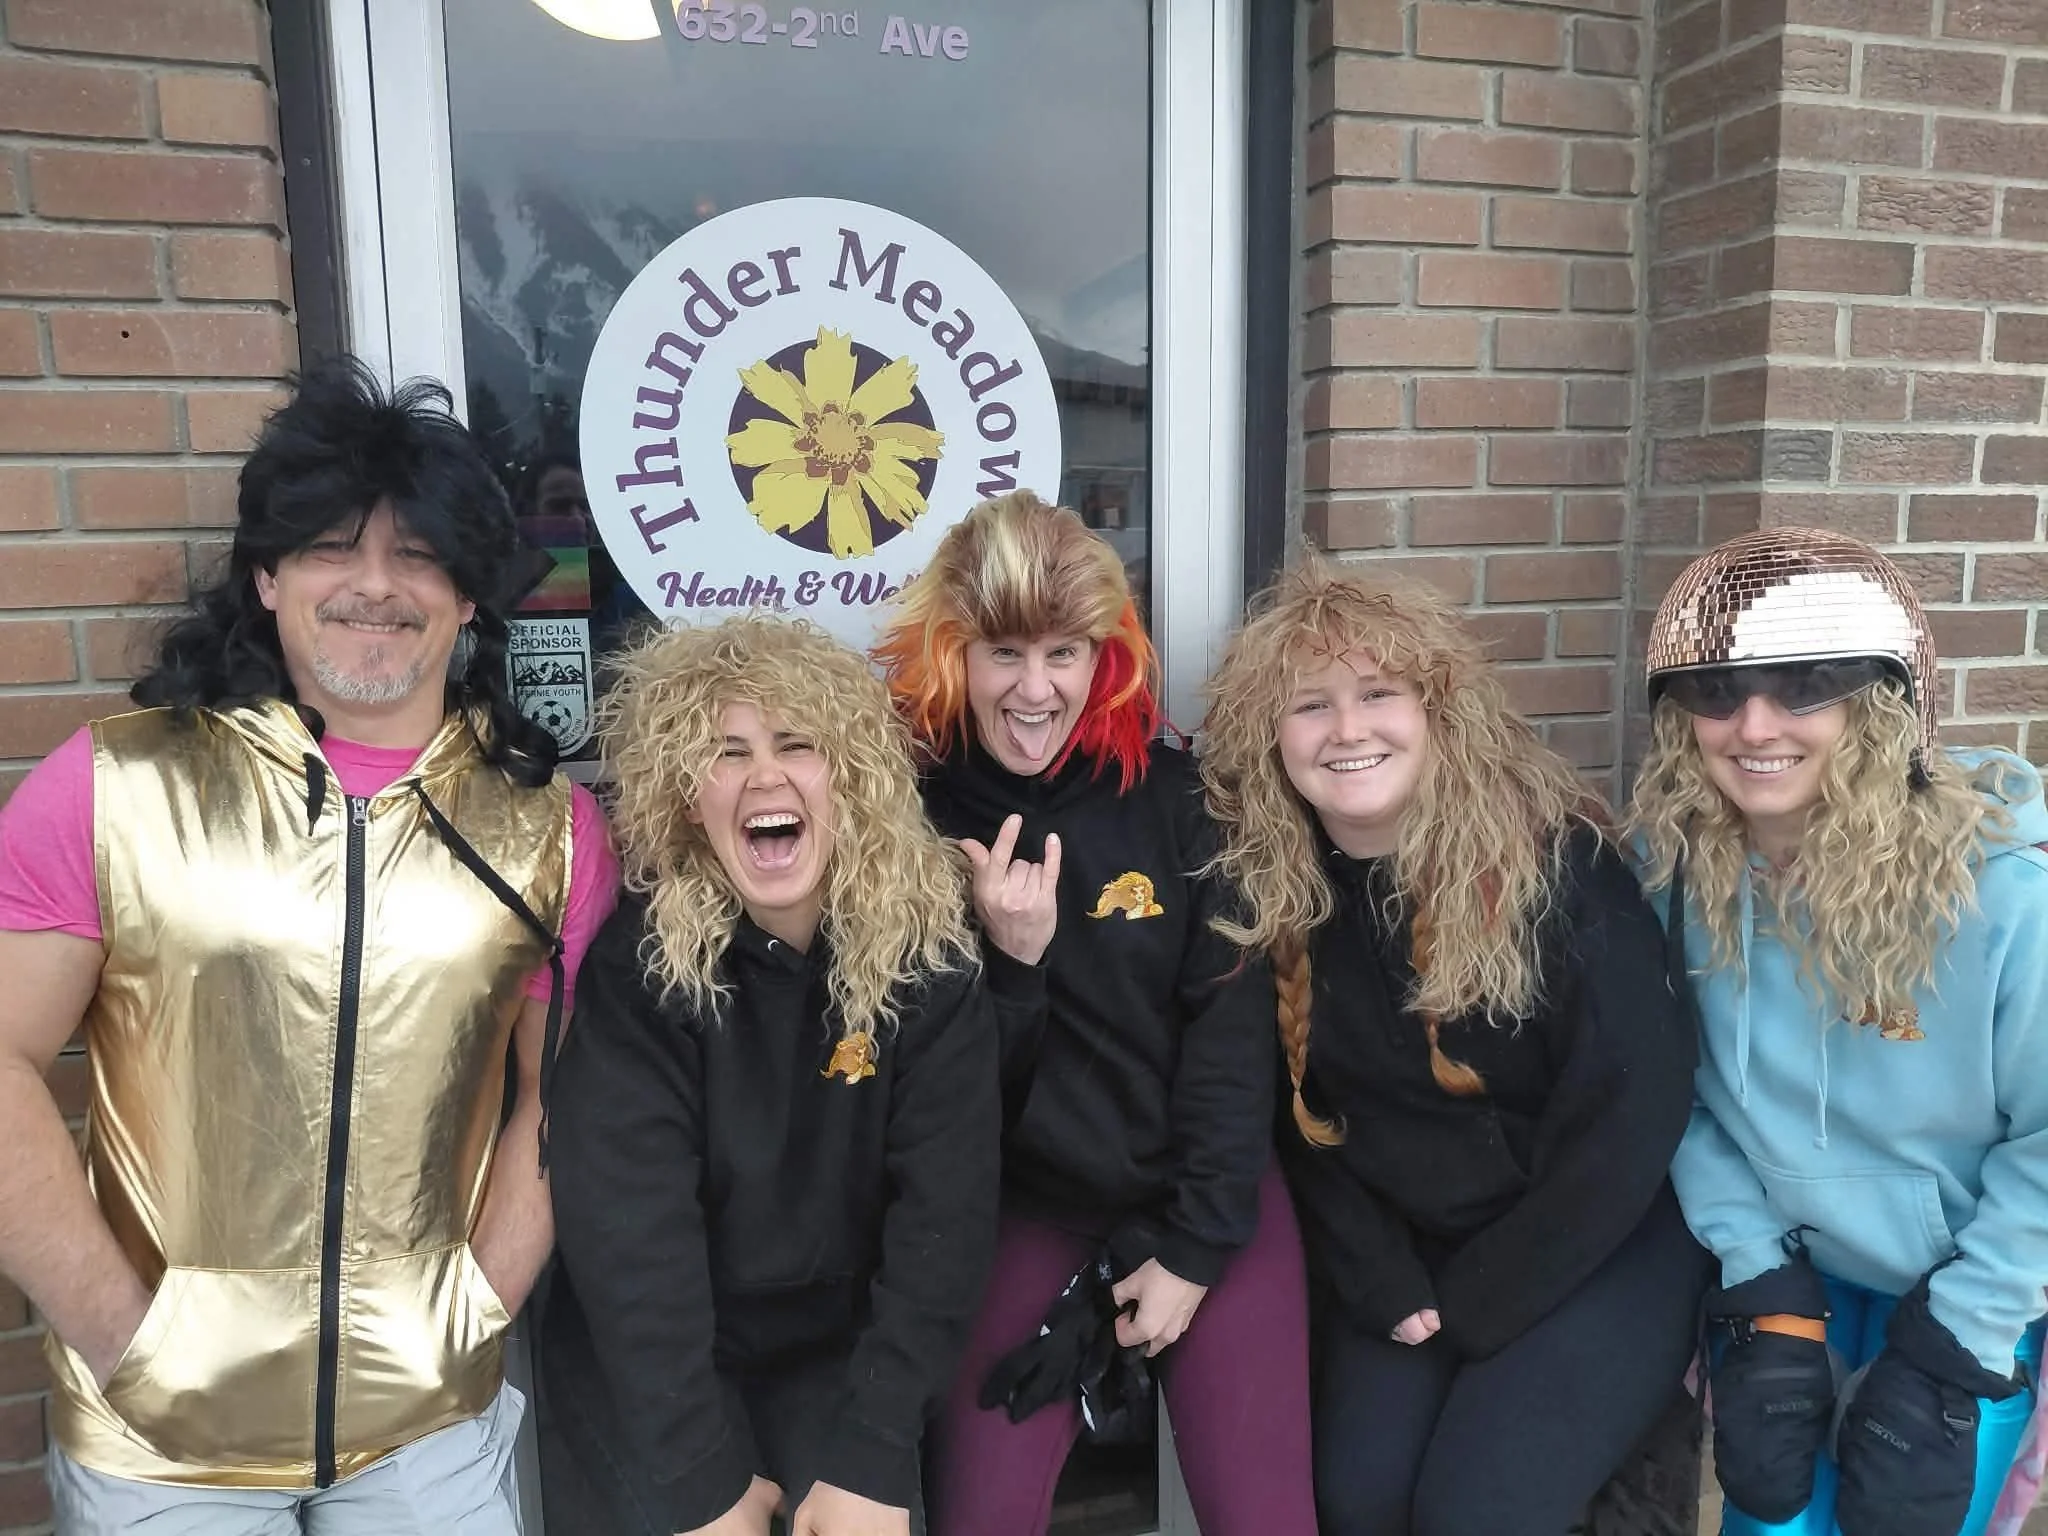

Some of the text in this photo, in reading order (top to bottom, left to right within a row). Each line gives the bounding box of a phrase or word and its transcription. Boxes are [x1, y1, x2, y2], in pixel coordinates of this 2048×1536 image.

[678, 0, 970, 61] 632-2nd Ave
[616, 227, 1024, 555] Thunder Meadow
[656, 571, 786, 612] Health
[795, 570, 826, 606] &
[511, 624, 581, 637] OFFICIAL
[511, 637, 582, 650] SPONSOR
[553, 687, 582, 697] YOUTH
